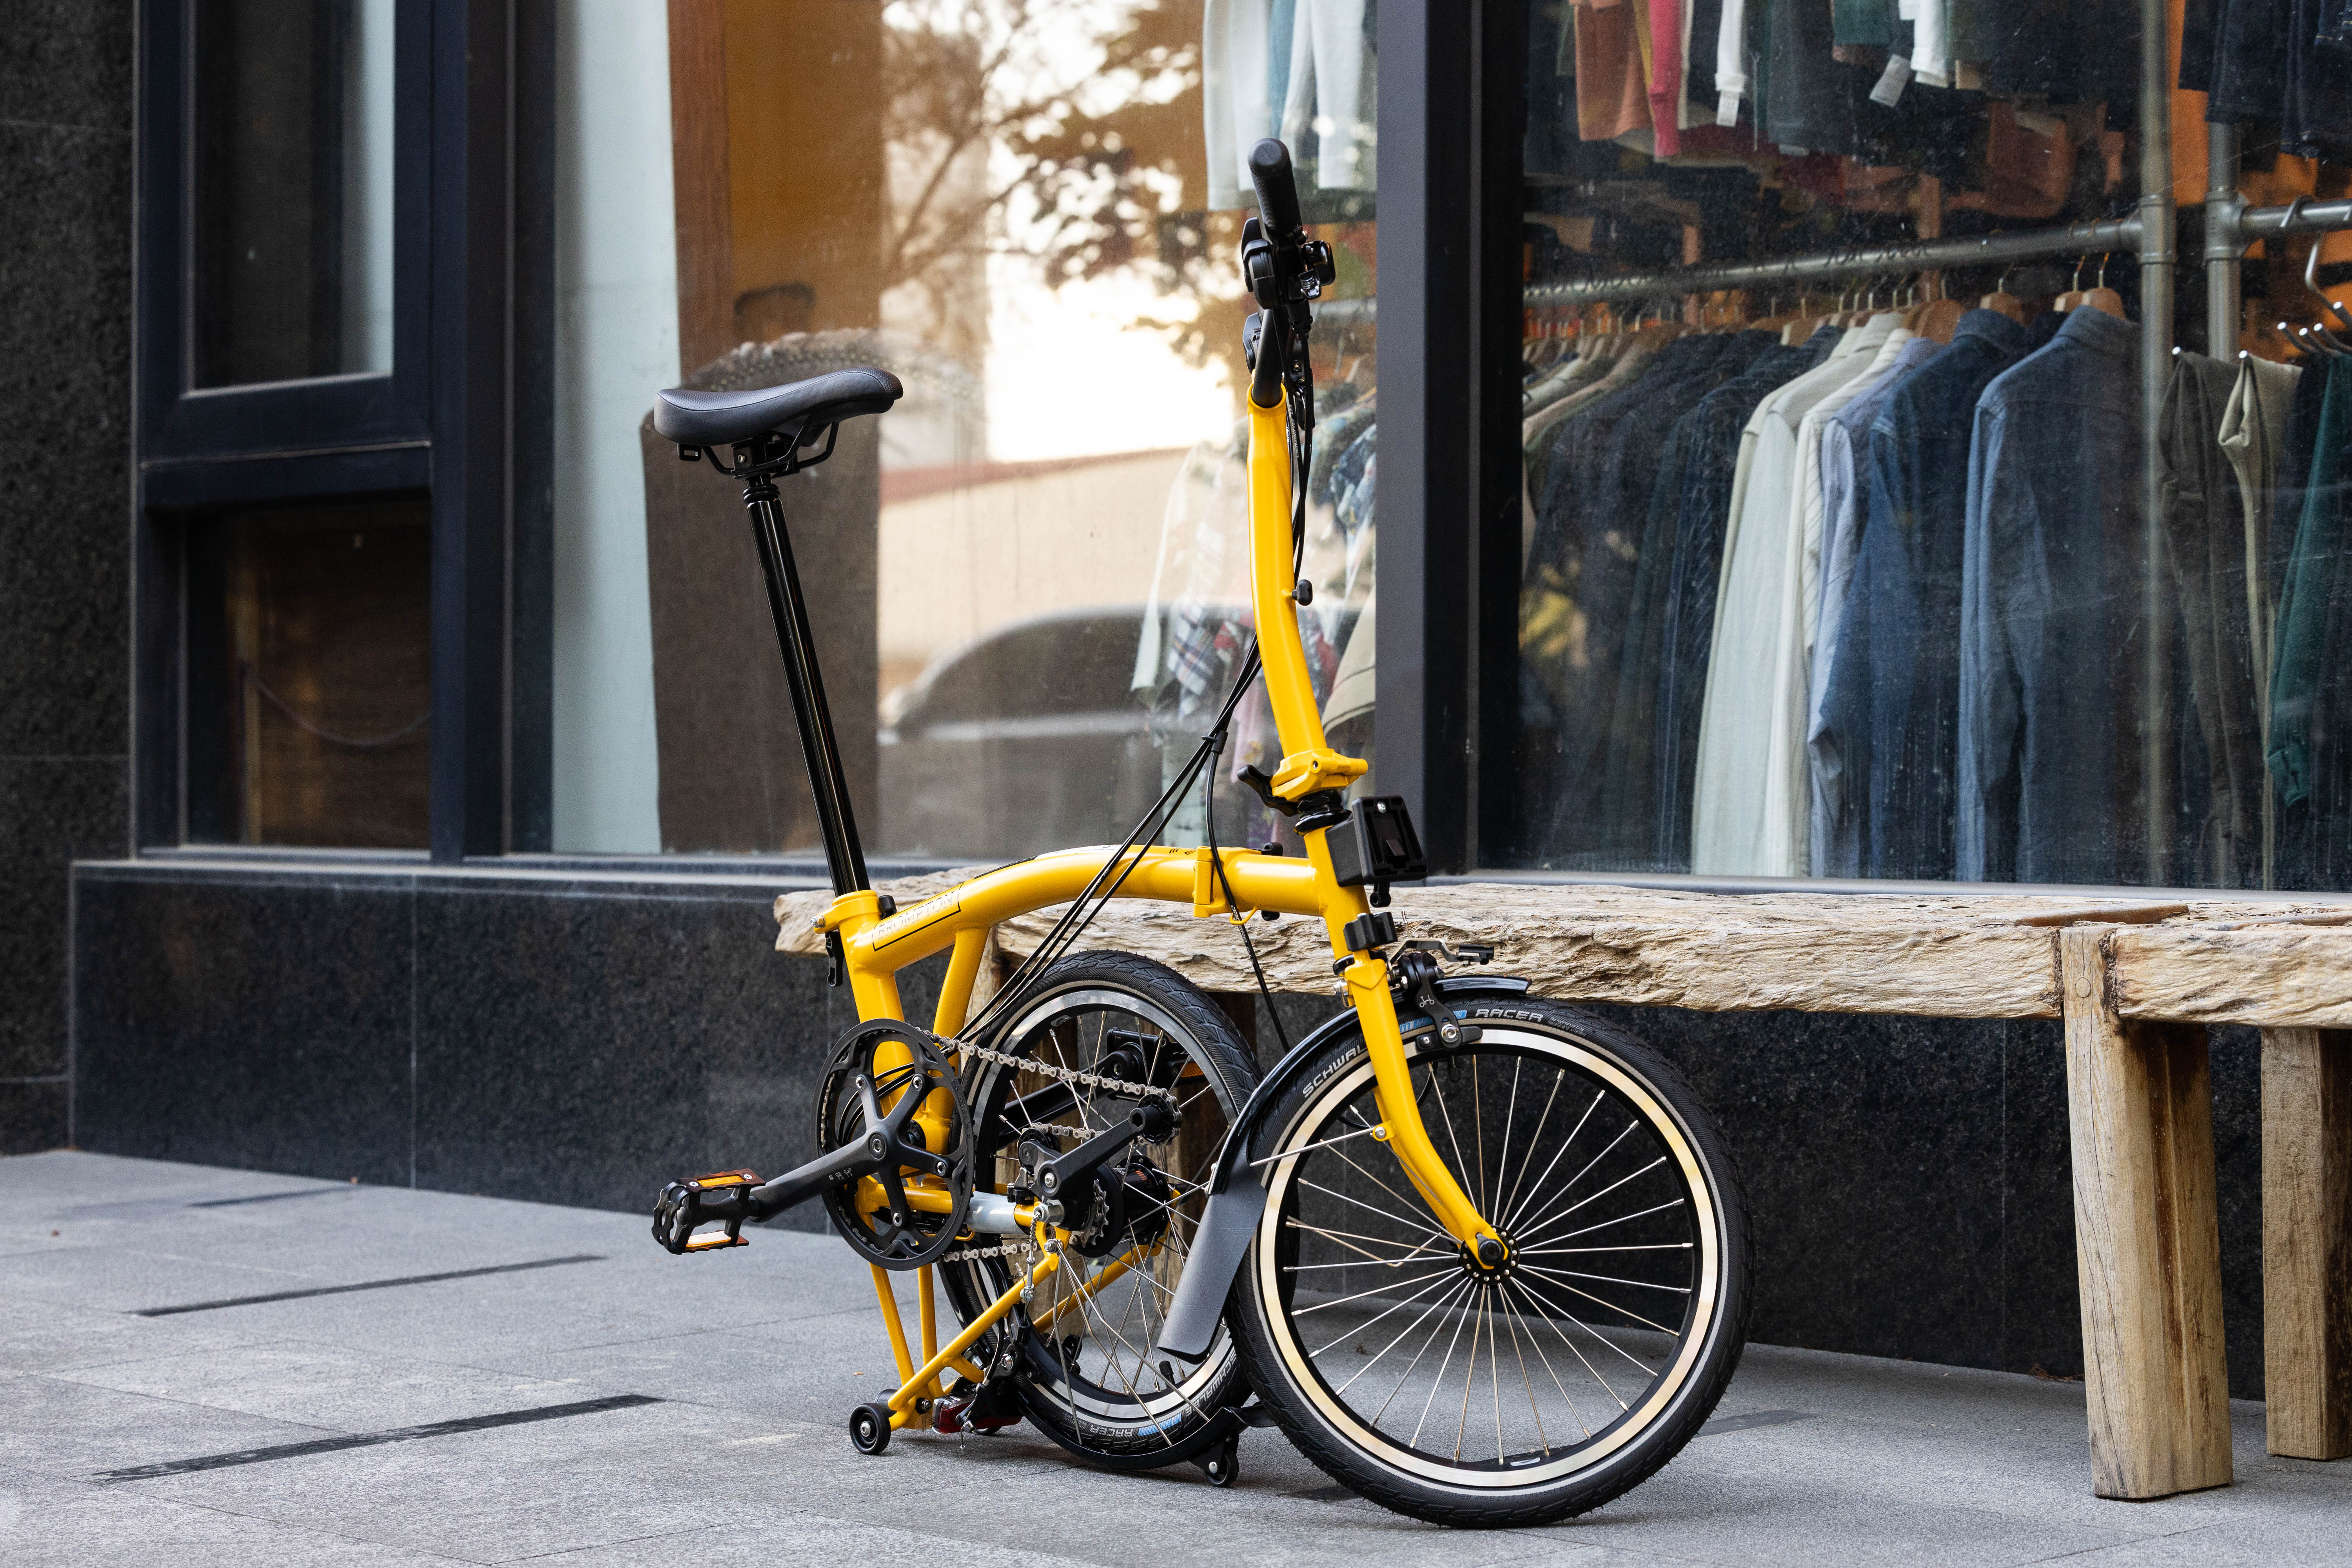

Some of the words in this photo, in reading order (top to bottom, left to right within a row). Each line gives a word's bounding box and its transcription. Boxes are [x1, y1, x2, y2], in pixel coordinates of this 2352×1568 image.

[878, 891, 955, 940] BROMPTON
[1474, 1009, 1543, 1022] RACER
[1303, 1045, 1368, 1098] SCHWAL
[1090, 1424, 1133, 1437] RACER
